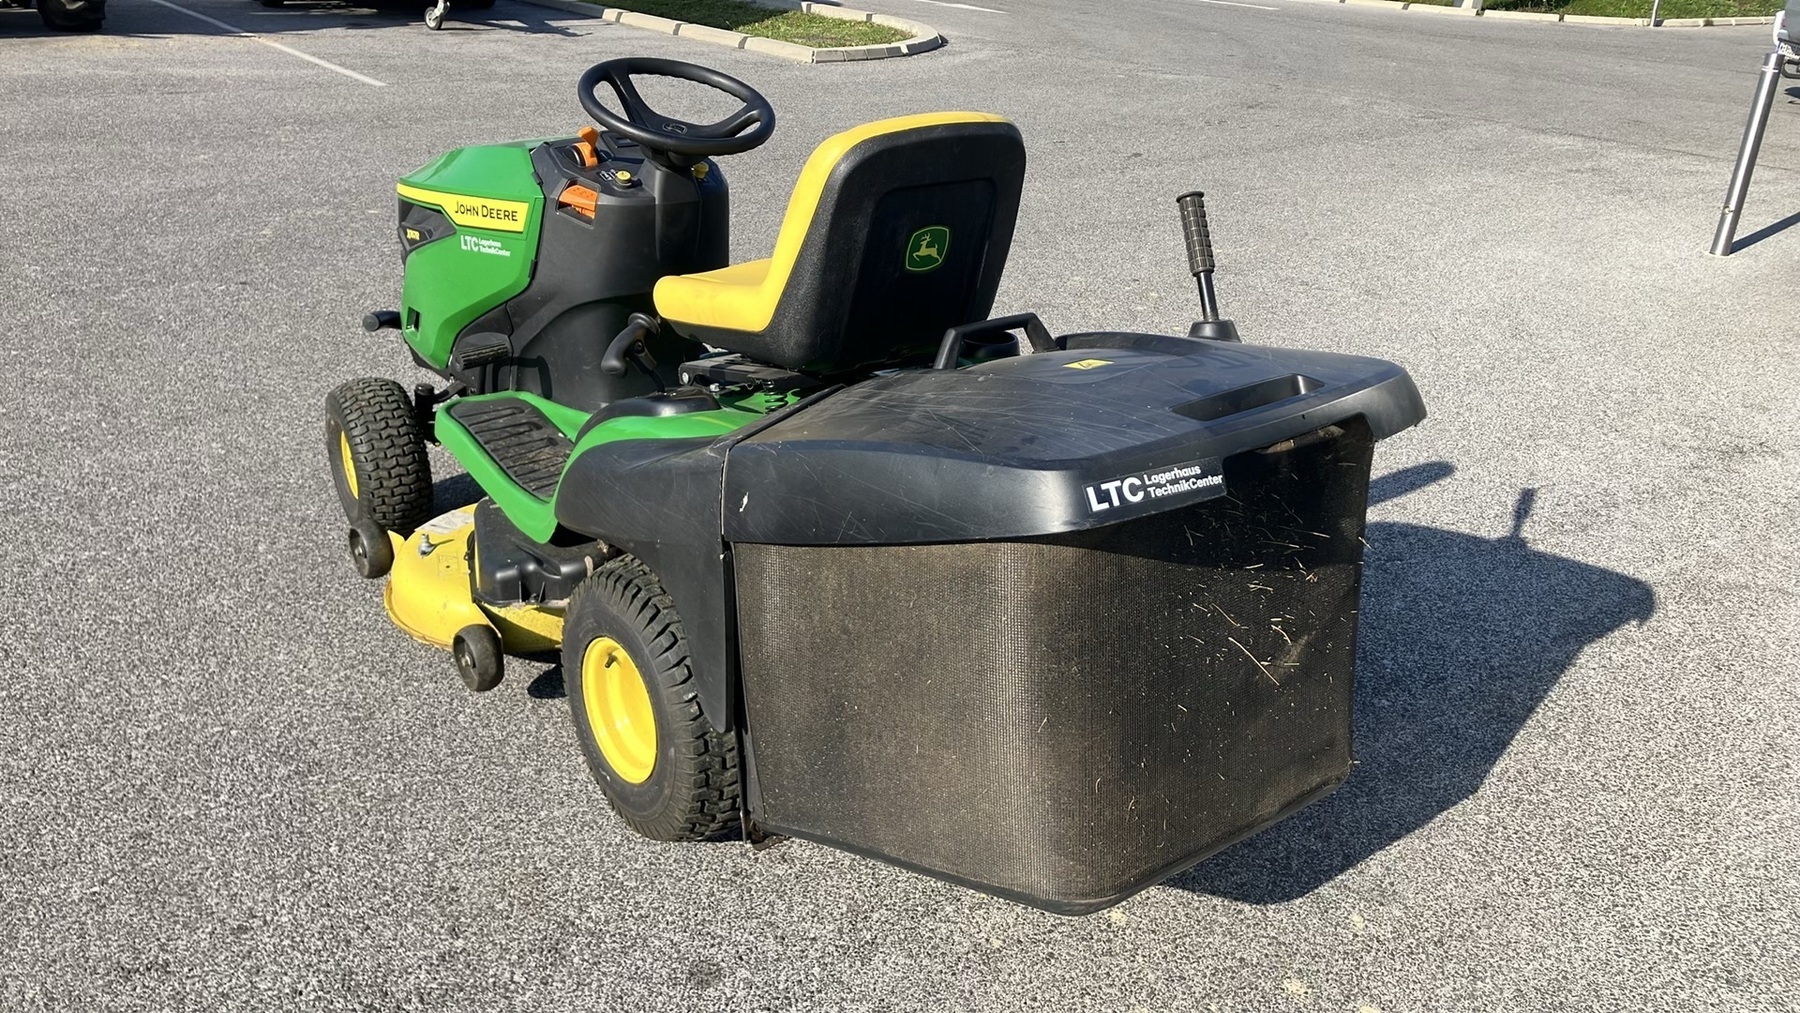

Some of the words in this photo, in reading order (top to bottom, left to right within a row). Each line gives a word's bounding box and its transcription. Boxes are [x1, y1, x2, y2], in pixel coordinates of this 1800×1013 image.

[455, 201, 479, 216] JOHN
[481, 204, 518, 222] DEERE
[460, 234, 479, 252] LTC
[1143, 465, 1201, 485] Lagerhaus
[1086, 477, 1144, 512] LTC
[1147, 474, 1223, 498] TechnikCenter
